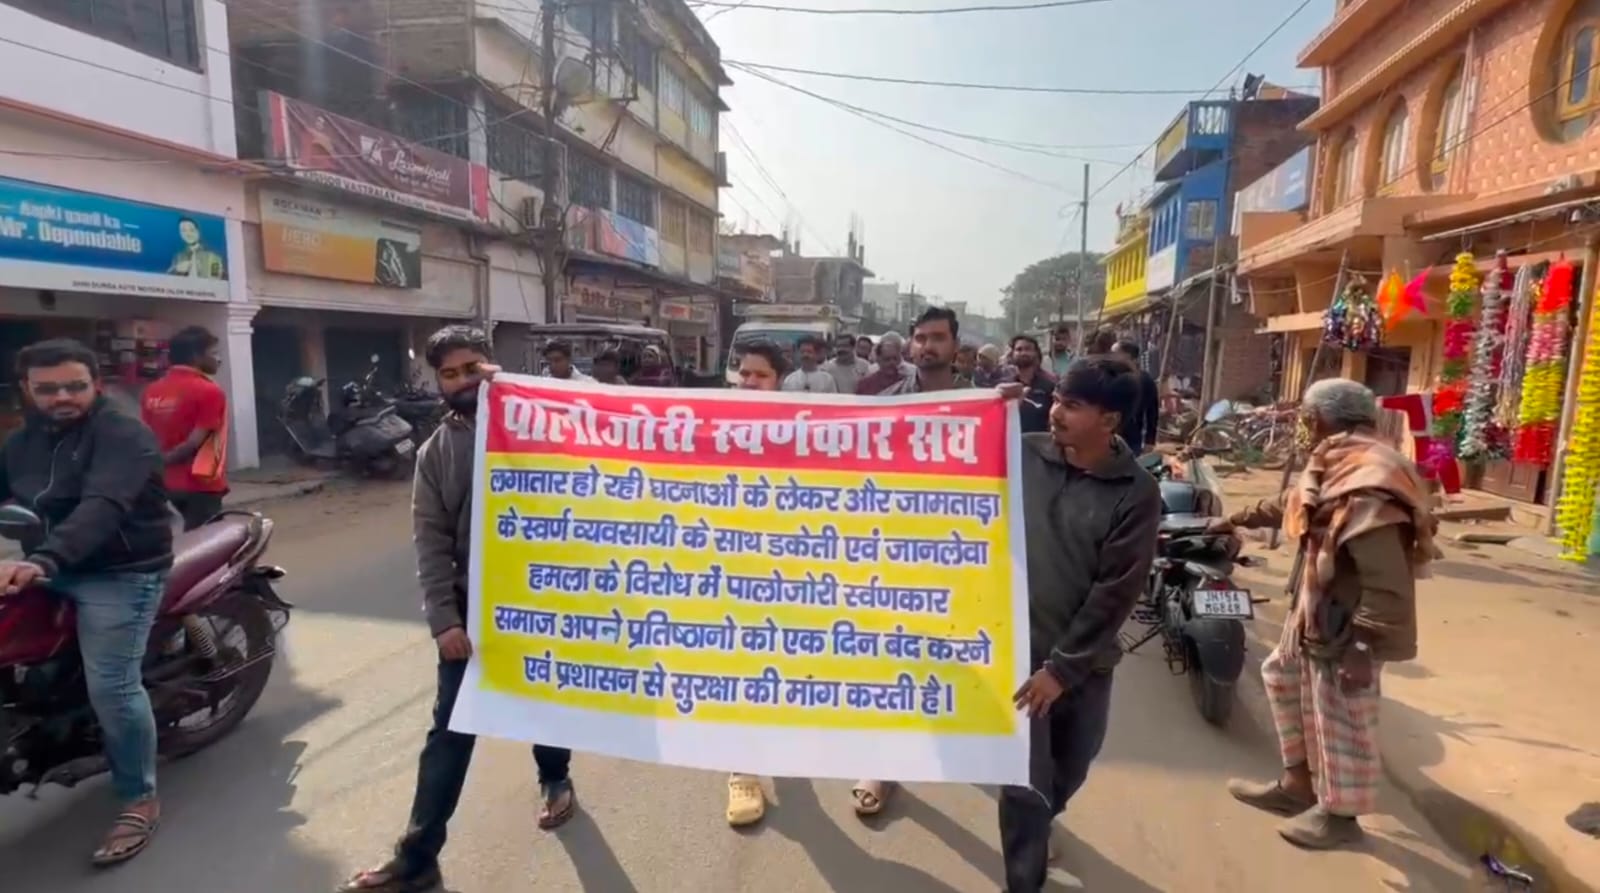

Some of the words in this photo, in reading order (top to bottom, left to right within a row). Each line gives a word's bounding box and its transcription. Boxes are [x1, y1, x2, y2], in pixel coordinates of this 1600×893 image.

[38, 221, 142, 253] Dependable
[104, 213, 121, 229] ka
[501, 394, 705, 453] पालोजोरी
[711, 410, 897, 461] स्वर्णकार
[905, 406, 982, 464] संघ
[489, 467, 572, 495] लगातार
[571, 464, 601, 498] हो
[603, 467, 645, 501] रही
[648, 473, 740, 507] घटनाओं
[742, 475, 772, 508] के
[777, 477, 843, 512] लेकर
[843, 478, 894, 514] और
[893, 489, 1001, 526] जामताड़ा
[497, 508, 520, 539] के
[519, 507, 572, 542] स्वर्ण
[572, 513, 679, 548] व्यवसायी
[681, 519, 711, 549] के
[713, 528, 764, 553] साथ
[843, 529, 881, 563] एवं
[883, 531, 989, 566] जानलेवा
[528, 563, 593, 593] हमला
[592, 560, 622, 593] के
[624, 559, 695, 597] विरोध
[697, 564, 723, 599] में
[725, 570, 840, 606] पालोजोरी
[494, 605, 558, 637] समाज
[559, 608, 625, 644] अपने
[626, 609, 738, 651] प्रतिष्ठानो
[740, 618, 779, 652] को
[781, 627, 828, 656] एक
[831, 620, 881, 657] दिन
[883, 626, 925, 660] बंद
[925, 630, 992, 665] करने
[524, 651, 553, 684] एवं
[554, 660, 640, 695] प्रशासन
[641, 662, 668, 698] से
[670, 672, 741, 715] सुरक्षा
[743, 666, 783, 705] की
[844, 672, 917, 711] करती
